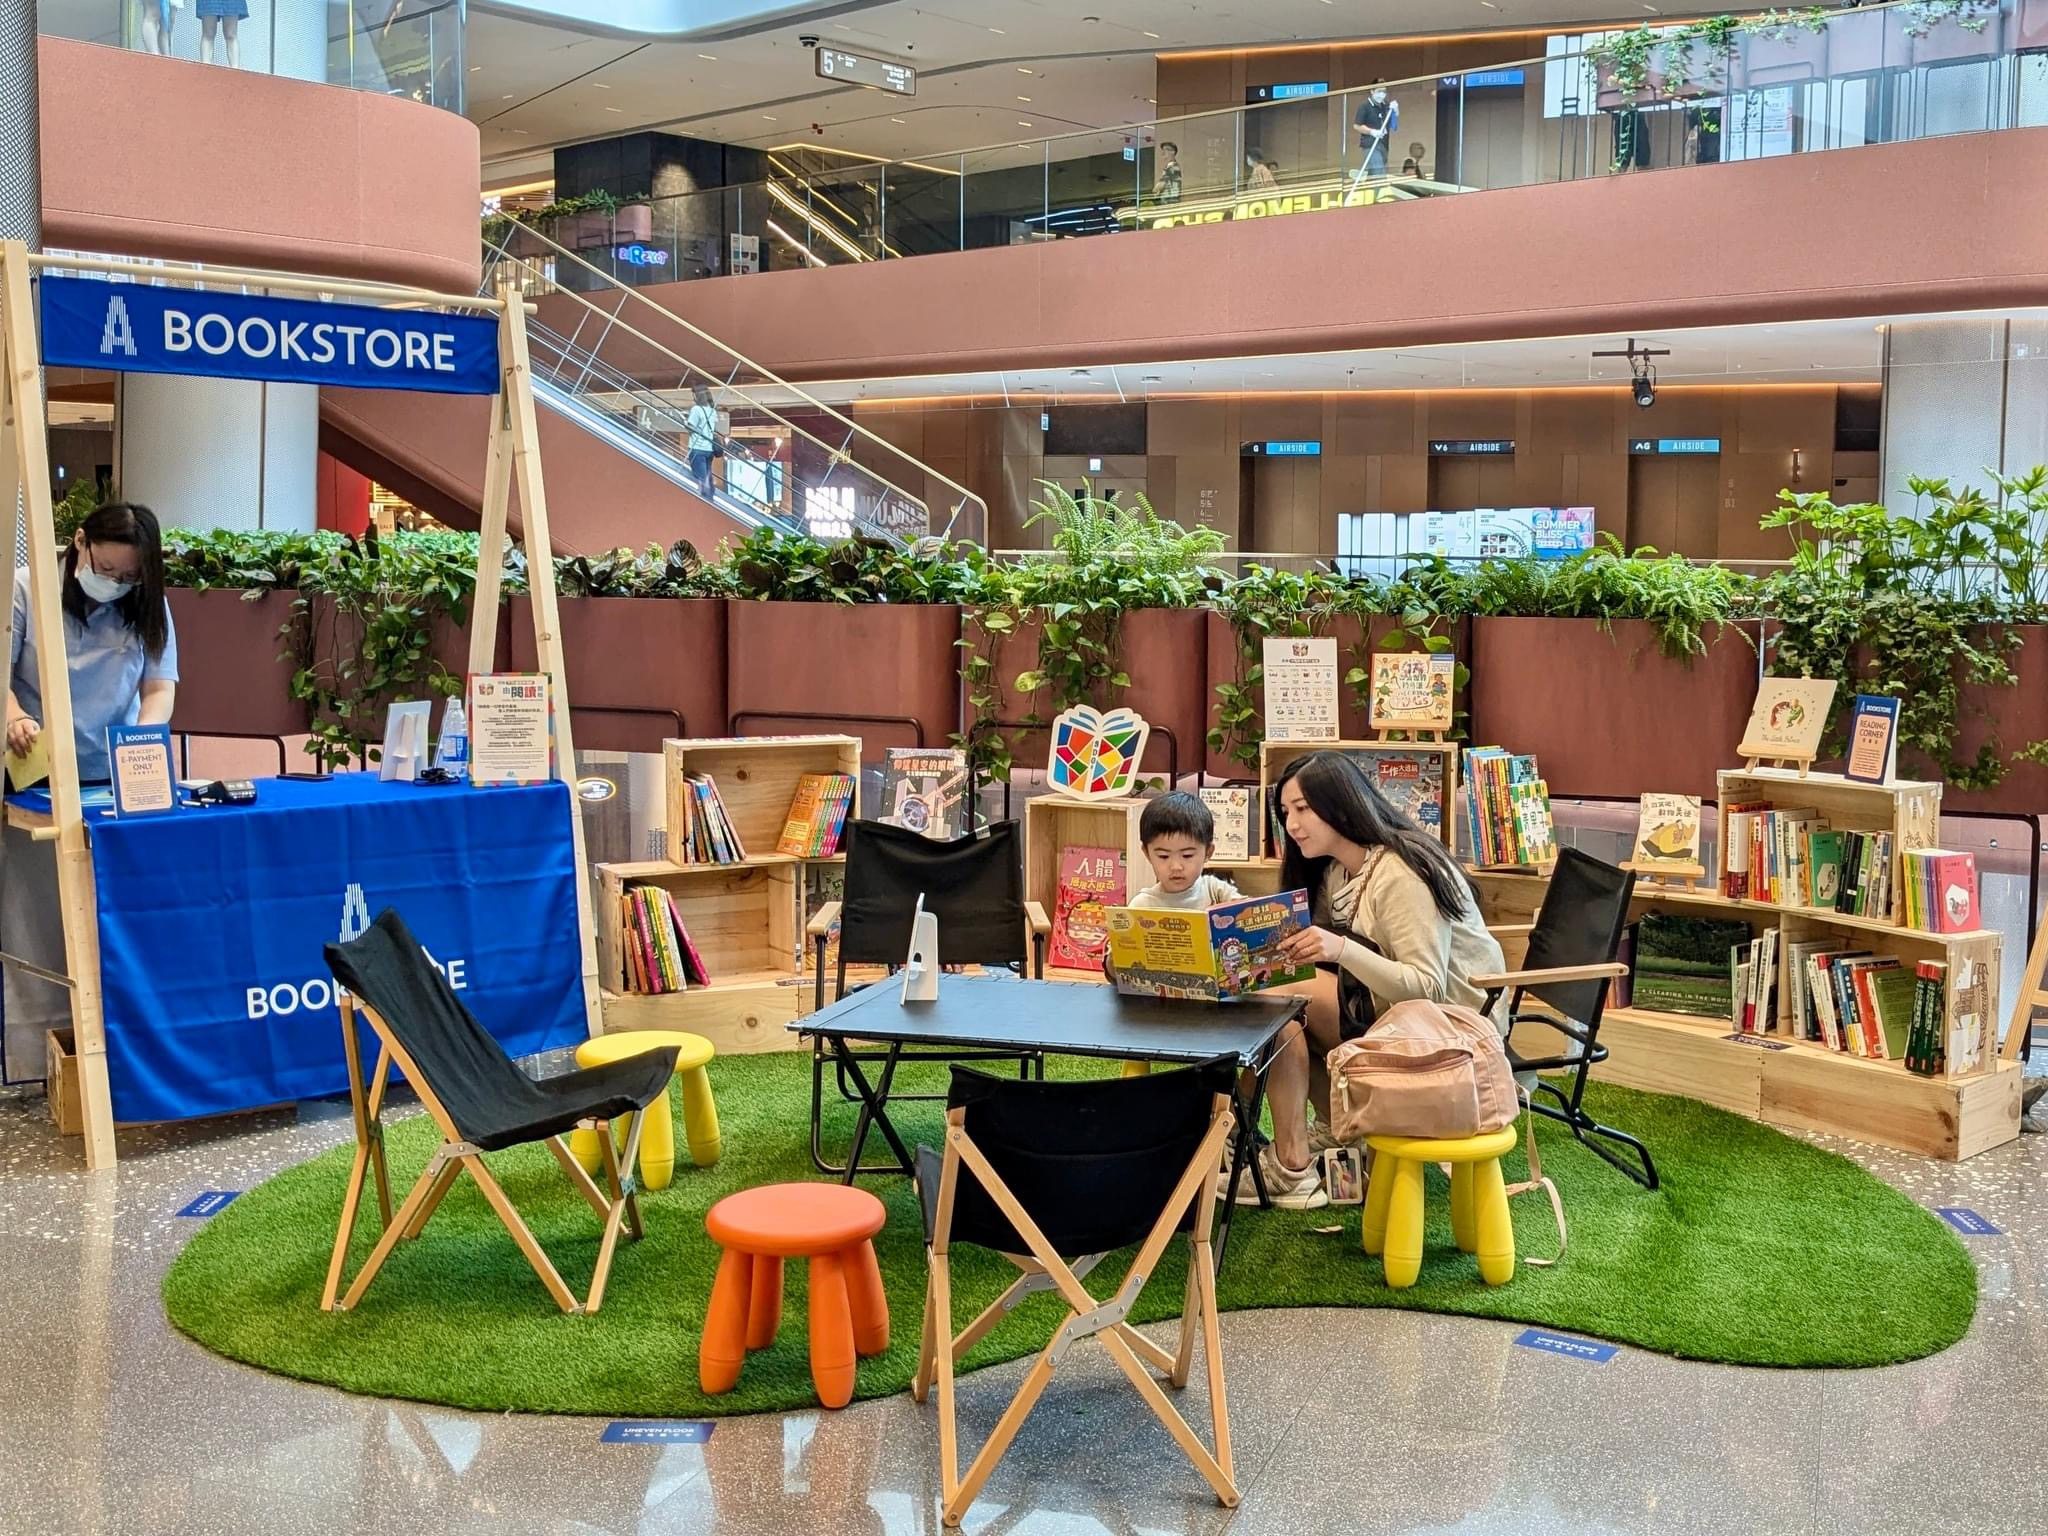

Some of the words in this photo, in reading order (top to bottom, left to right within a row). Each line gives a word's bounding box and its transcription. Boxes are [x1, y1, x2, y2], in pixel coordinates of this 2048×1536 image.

[823, 51, 834, 74] 5
[163, 309, 456, 372] BOOKSTORE
[1278, 444, 1307, 453] AIRSIDE
[1469, 443, 1500, 452] AIRSIDE
[1672, 441, 1705, 450] AIRSIDE
[1536, 520, 1580, 530] SUMMER
[1536, 530, 1562, 539] BLISS
[1860, 720, 1887, 730] READING
[125, 733, 164, 742] BOOKSTORE
[1859, 728, 1884, 738] CORNER
[121, 754, 162, 763] E-PAYMENT
[133, 763, 153, 771] ONLY
[1074, 857, 1114, 878] 人體
[246, 945, 468, 1020] BOOKE
[1648, 990, 1682, 998] CLEARING
